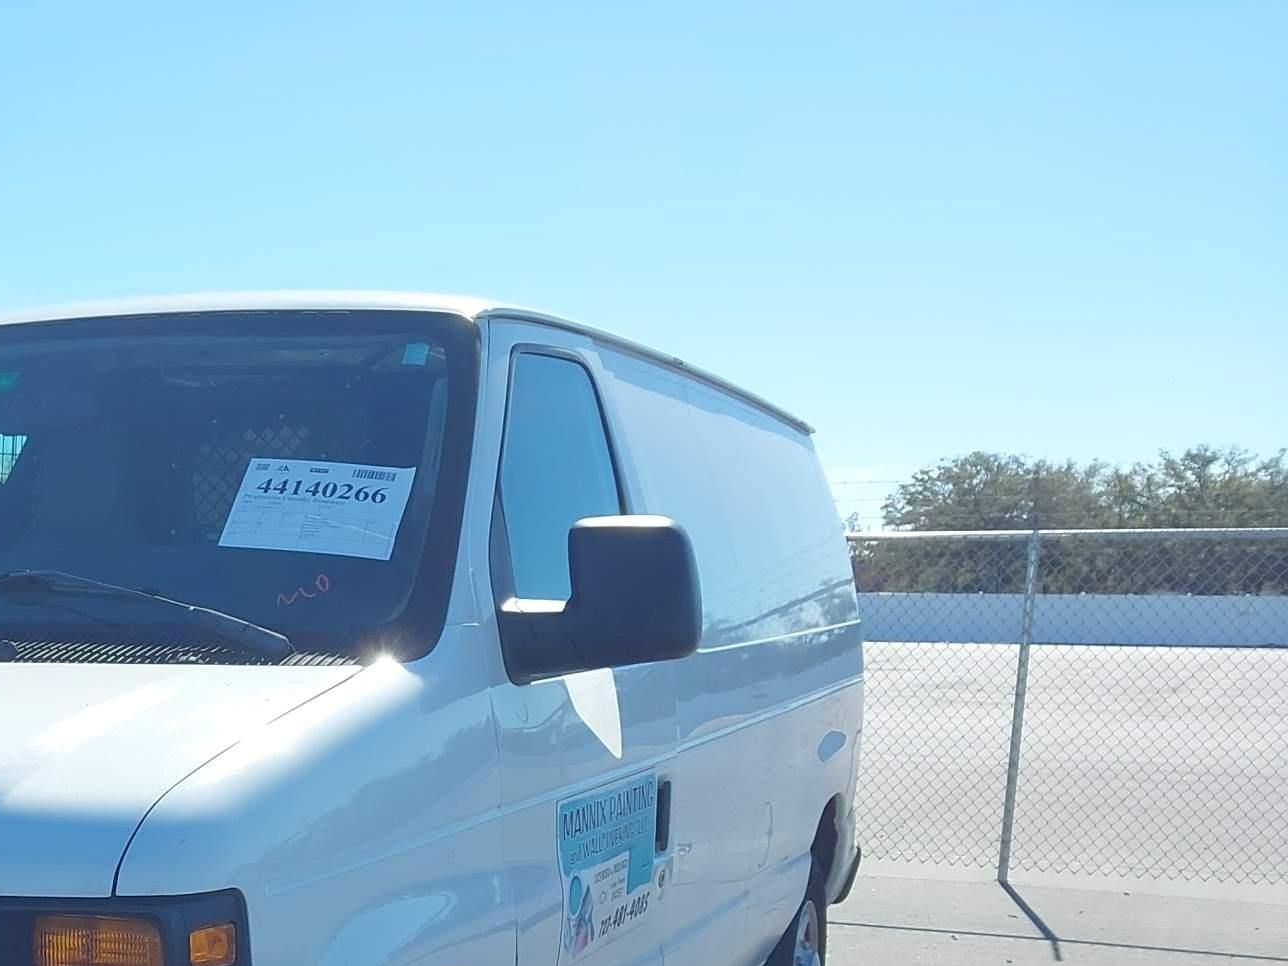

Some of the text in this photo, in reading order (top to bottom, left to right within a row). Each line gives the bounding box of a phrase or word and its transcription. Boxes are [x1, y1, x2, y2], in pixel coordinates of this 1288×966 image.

[256, 478, 389, 504] 44140266
[563, 780, 654, 841] MANNIX PAINTING
[568, 843, 582, 865] and
